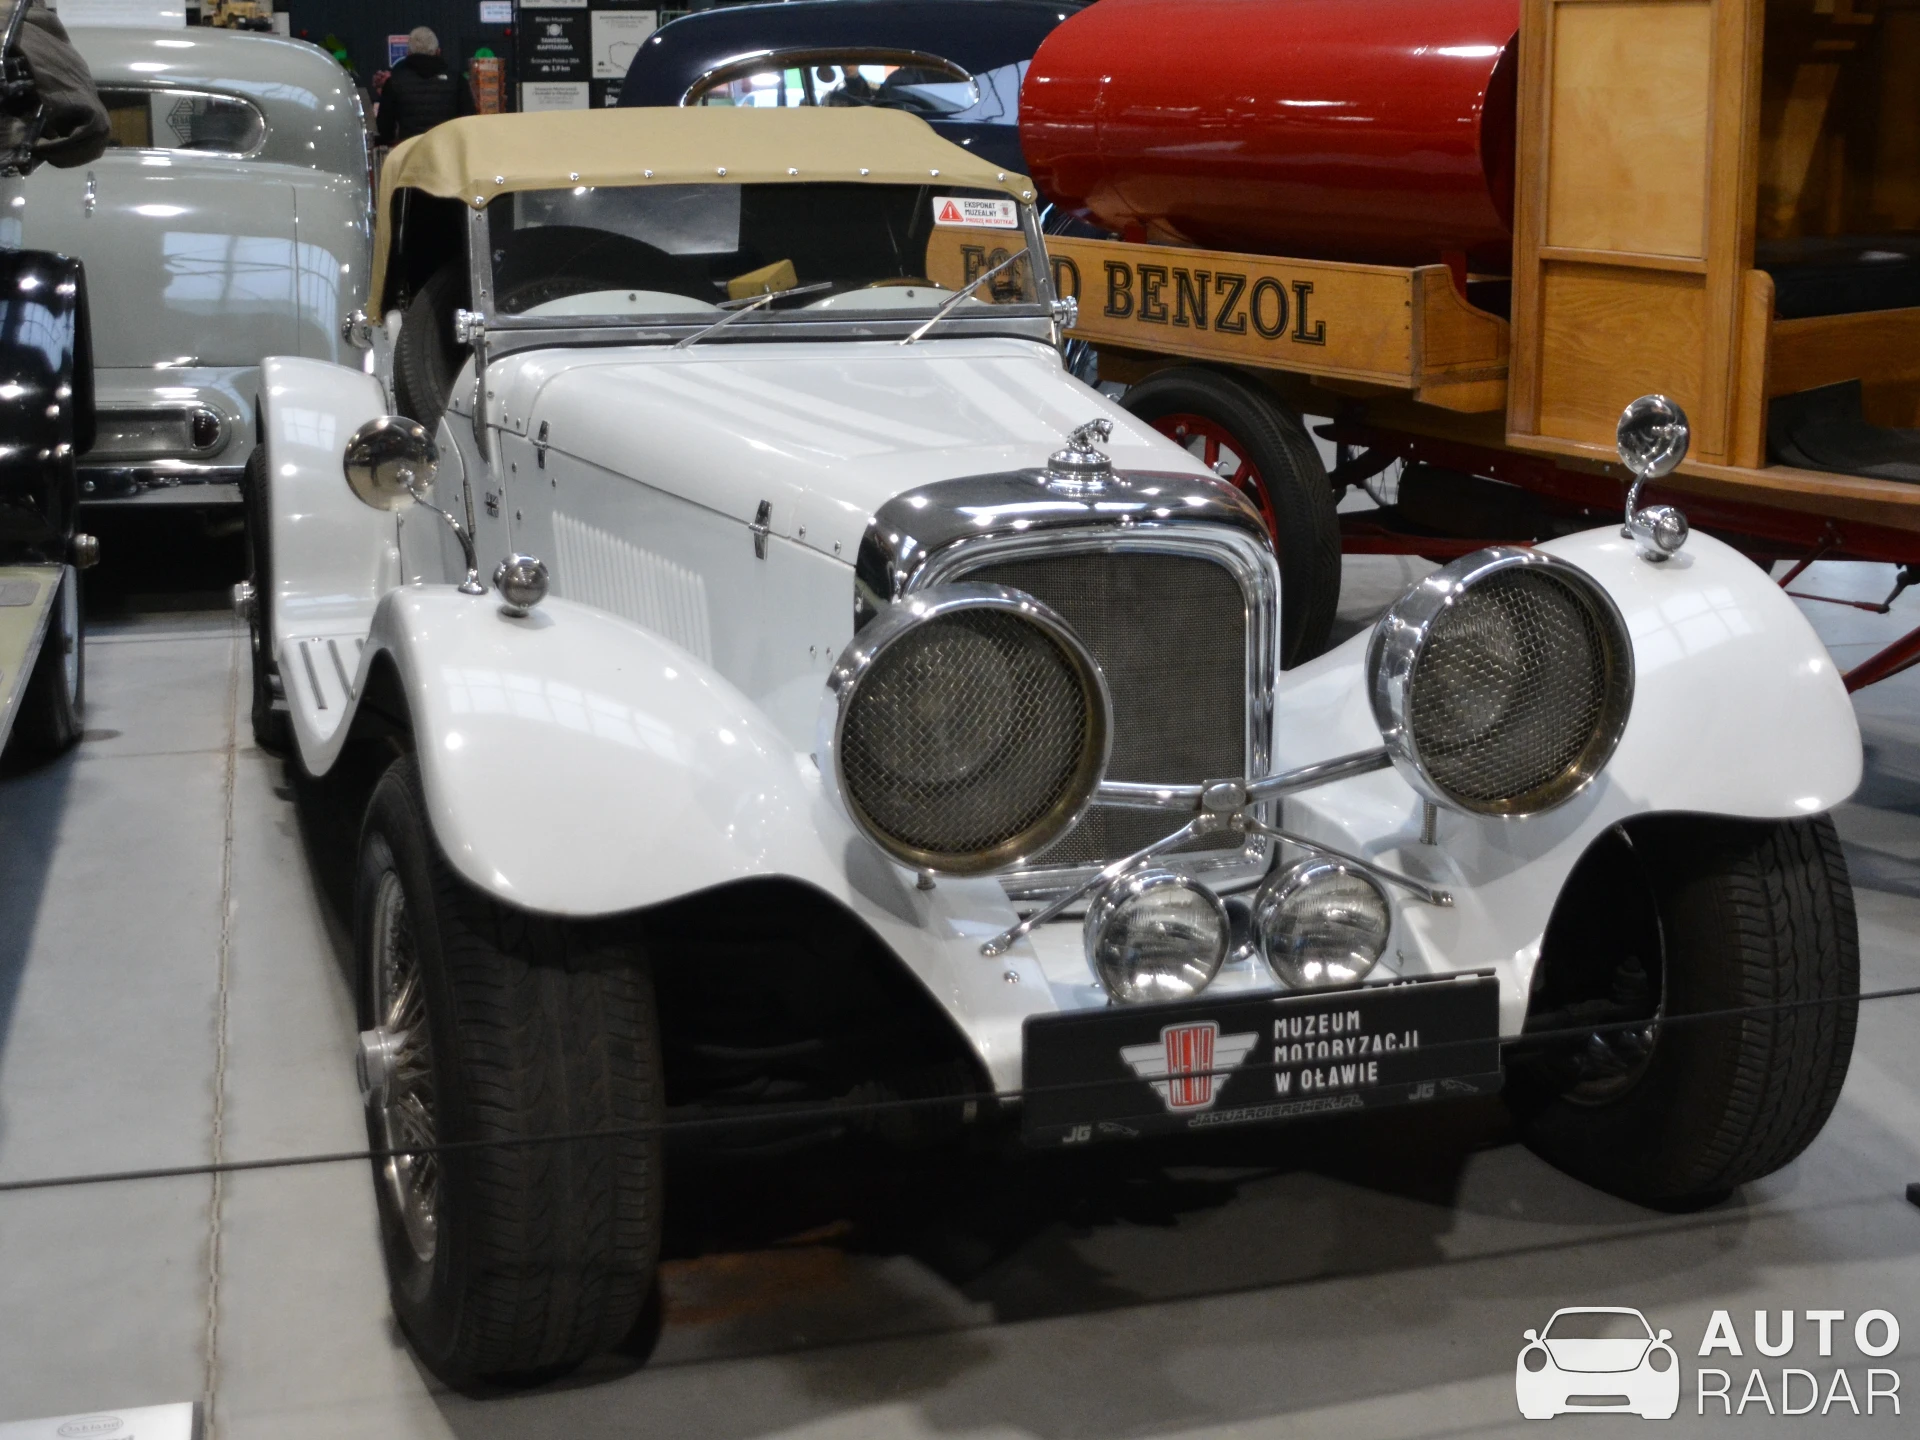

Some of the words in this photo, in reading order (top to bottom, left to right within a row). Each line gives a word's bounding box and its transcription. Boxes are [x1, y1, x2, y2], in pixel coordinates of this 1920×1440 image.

[964, 201, 995, 209] EKSPONAT
[965, 209, 997, 217] MUZEALNY
[1104, 260, 1326, 346] BENZOL
[1274, 1010, 1361, 1039] MUZEUM
[1274, 1030, 1419, 1063] MOTORYZACJI
[1275, 1071, 1291, 1093] W
[1301, 1061, 1378, 1089] OŁAWIE
[1408, 1083, 1435, 1100] JG
[1062, 1124, 1092, 1142] JG
